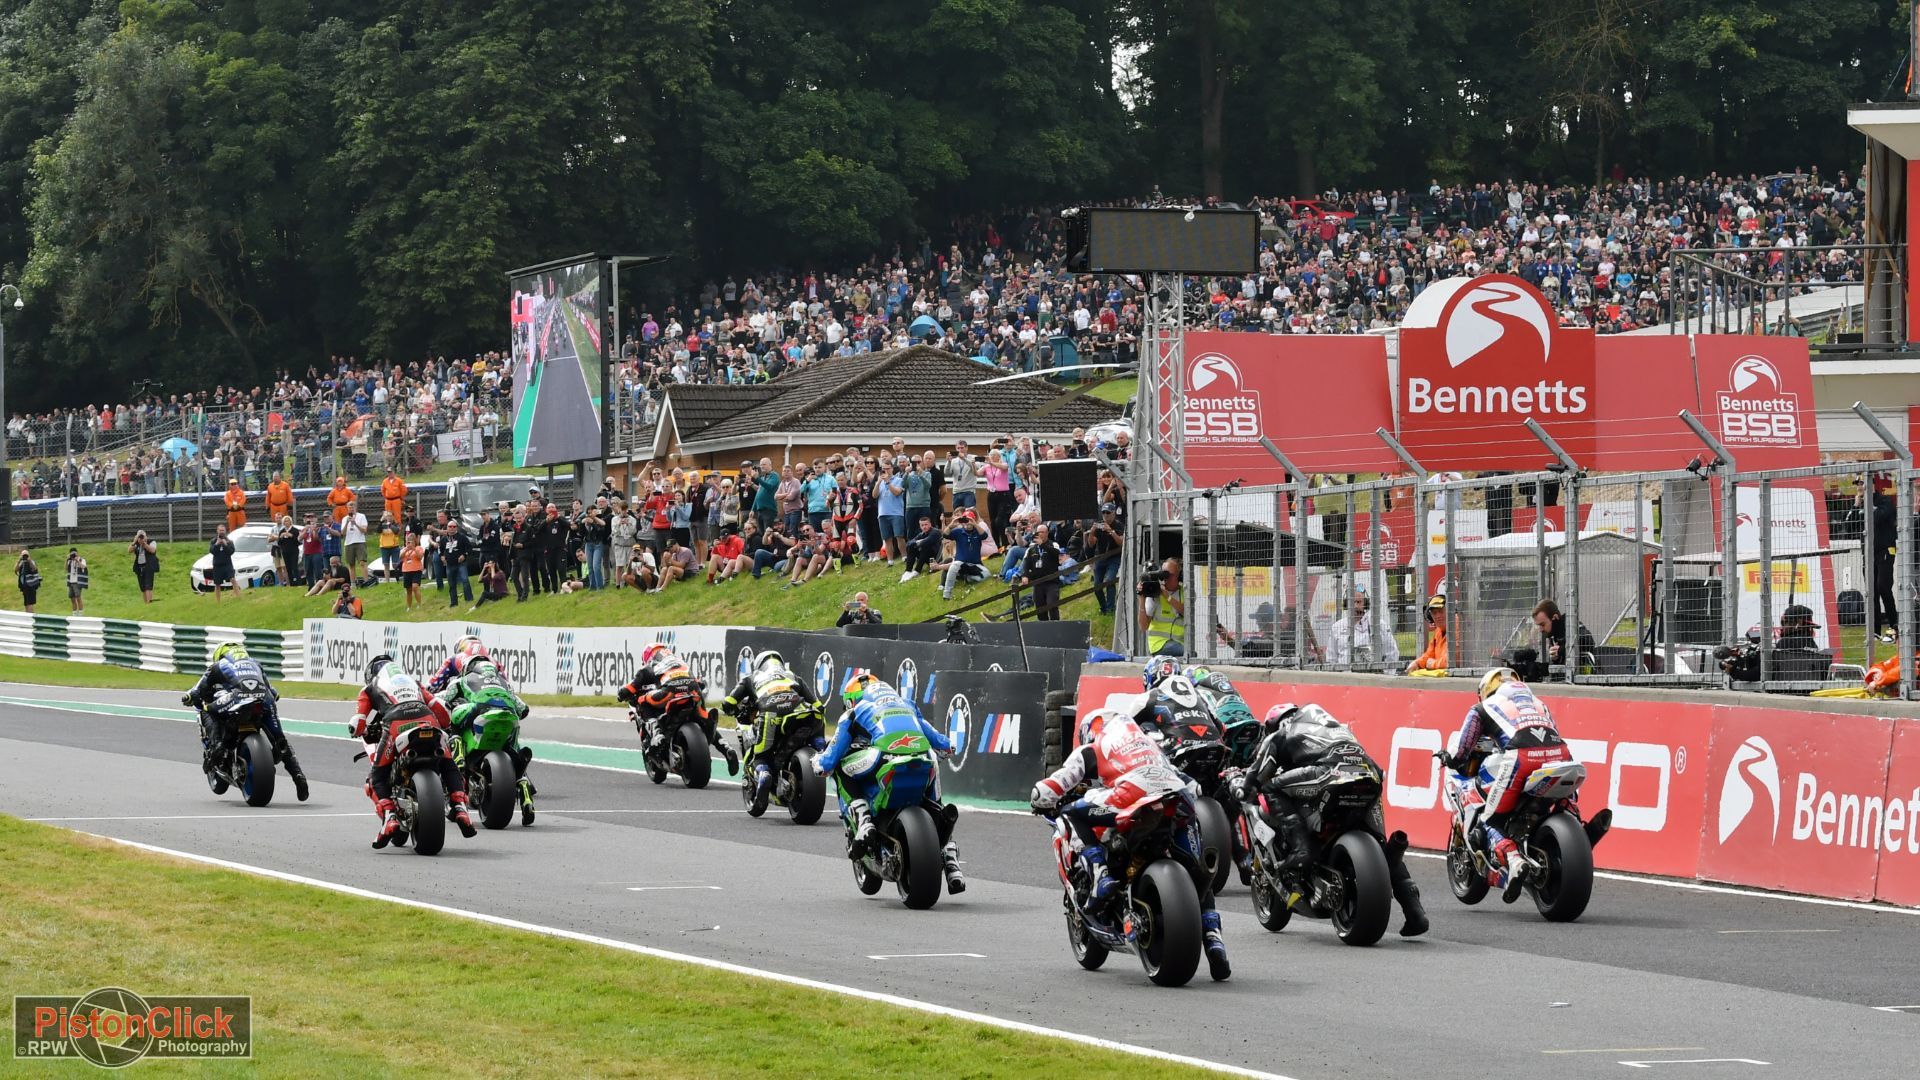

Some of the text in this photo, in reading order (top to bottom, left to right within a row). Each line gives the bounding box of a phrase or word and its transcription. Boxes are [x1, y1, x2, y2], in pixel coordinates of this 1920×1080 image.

[1184, 395, 1256, 410] Bennetts
[1408, 377, 1587, 414] Bennetts
[1721, 396, 1795, 412] Bennetts
[1184, 412, 1259, 436] BSB
[1722, 413, 1797, 437] BSB
[1757, 517, 1807, 528] nnetts
[326, 632, 368, 682] xograph
[577, 639, 635, 695] xograph
[1793, 772, 1920, 854] Bennet
